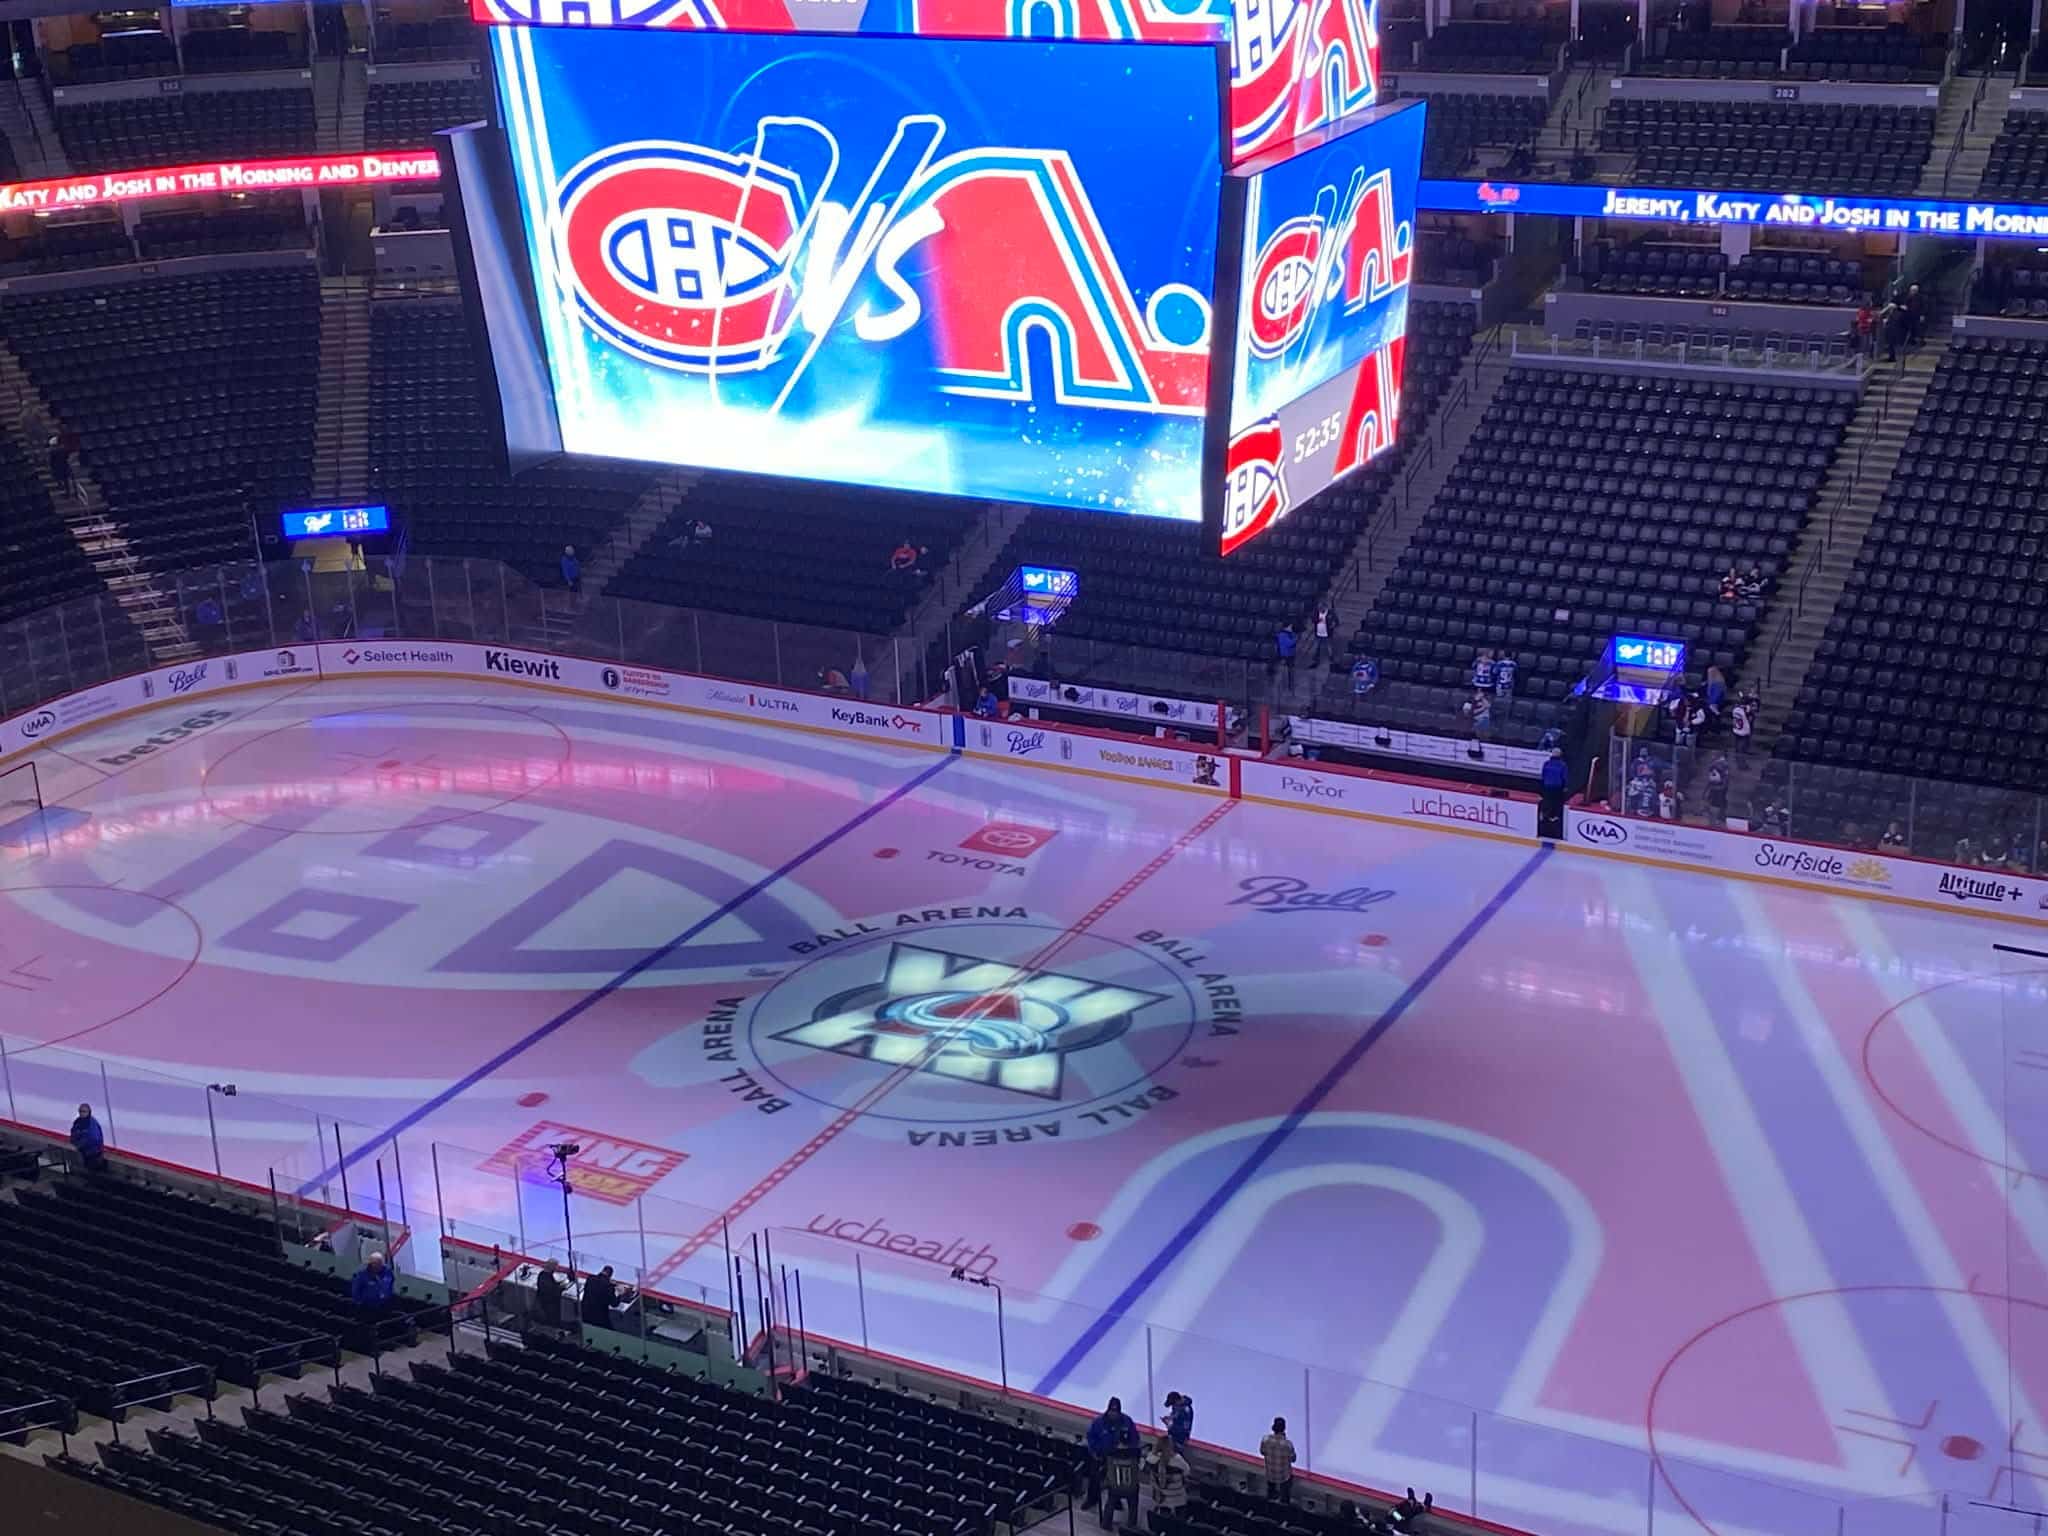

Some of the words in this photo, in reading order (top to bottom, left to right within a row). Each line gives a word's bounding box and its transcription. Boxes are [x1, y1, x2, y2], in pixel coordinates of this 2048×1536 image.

[1294, 411, 1342, 464] 52:35
[363, 650, 408, 663] Select
[410, 650, 454, 664] Health
[485, 649, 561, 680] Kiewit
[168, 662, 208, 692] Ball
[758, 698, 801, 713] ULTRA
[831, 707, 890, 729] KeyBank
[97, 708, 233, 766] bet365
[1007, 730, 1045, 755] Ball
[1281, 776, 1345, 799] Paycor
[1410, 793, 1511, 828] uchealth
[1586, 823, 1619, 839] IMA
[926, 850, 1026, 877] TOYOTA
[1755, 843, 1843, 875] Surfside
[1224, 875, 1396, 914] Ball
[789, 921, 880, 954] BALL
[896, 906, 1028, 926] ARENA
[1134, 930, 1206, 968] BALL
[1195, 973, 1243, 1037] ARENA
[703, 996, 746, 1062] ARENA
[720, 1067, 792, 1114] BALL
[1078, 1085, 1180, 1125] BALL
[907, 1120, 1061, 1147] ARENA
[807, 1213, 998, 1276] uchealth
